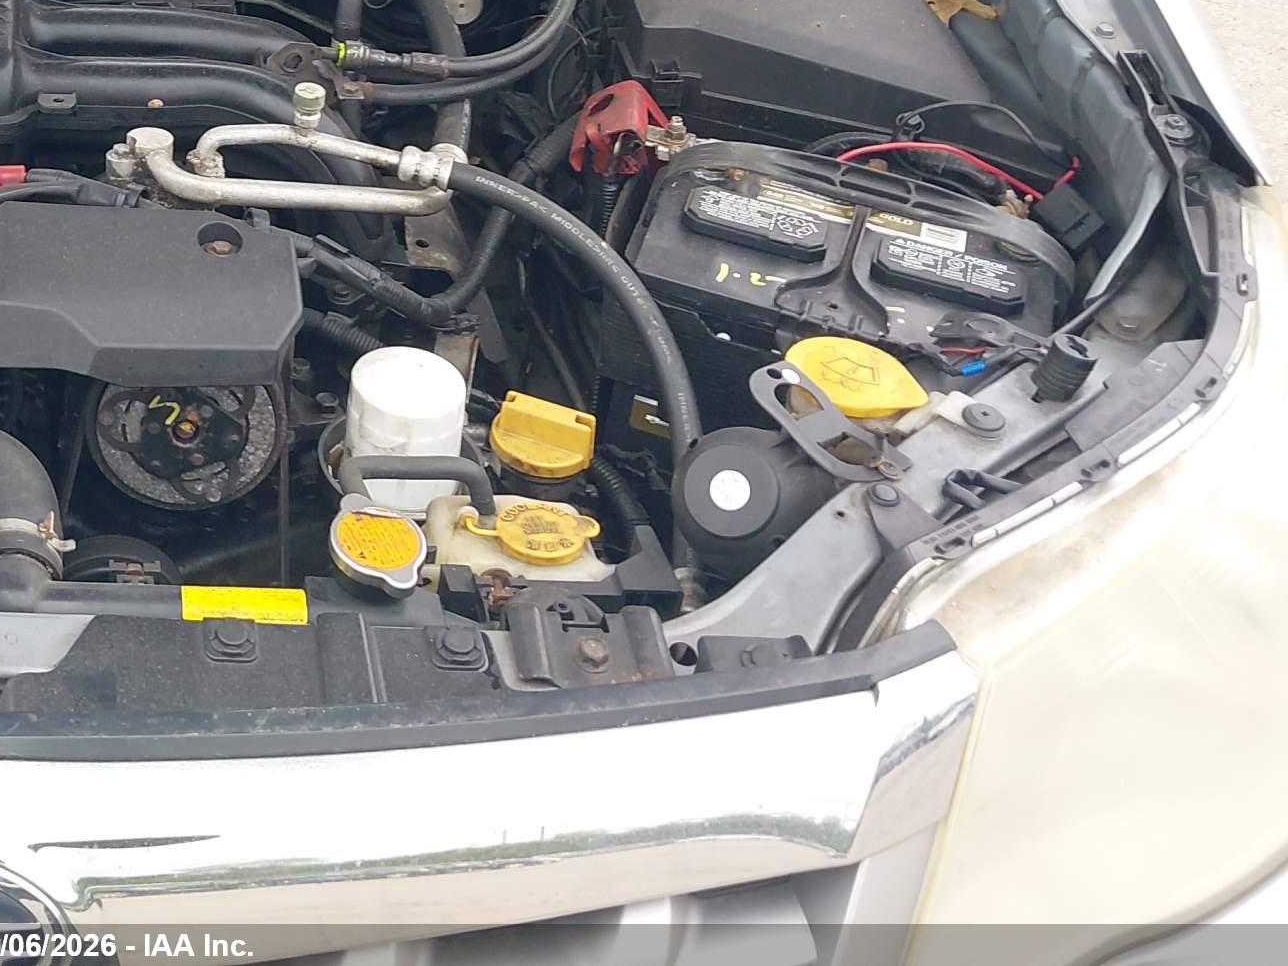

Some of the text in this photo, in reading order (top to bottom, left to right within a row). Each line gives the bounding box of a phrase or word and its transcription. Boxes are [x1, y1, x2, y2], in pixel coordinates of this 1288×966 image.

[878, 212, 913, 227] GOLD
[905, 240, 953, 258] DANGER
[964, 255, 1008, 271] POISON
[500, 502, 570, 523] COOLANT
